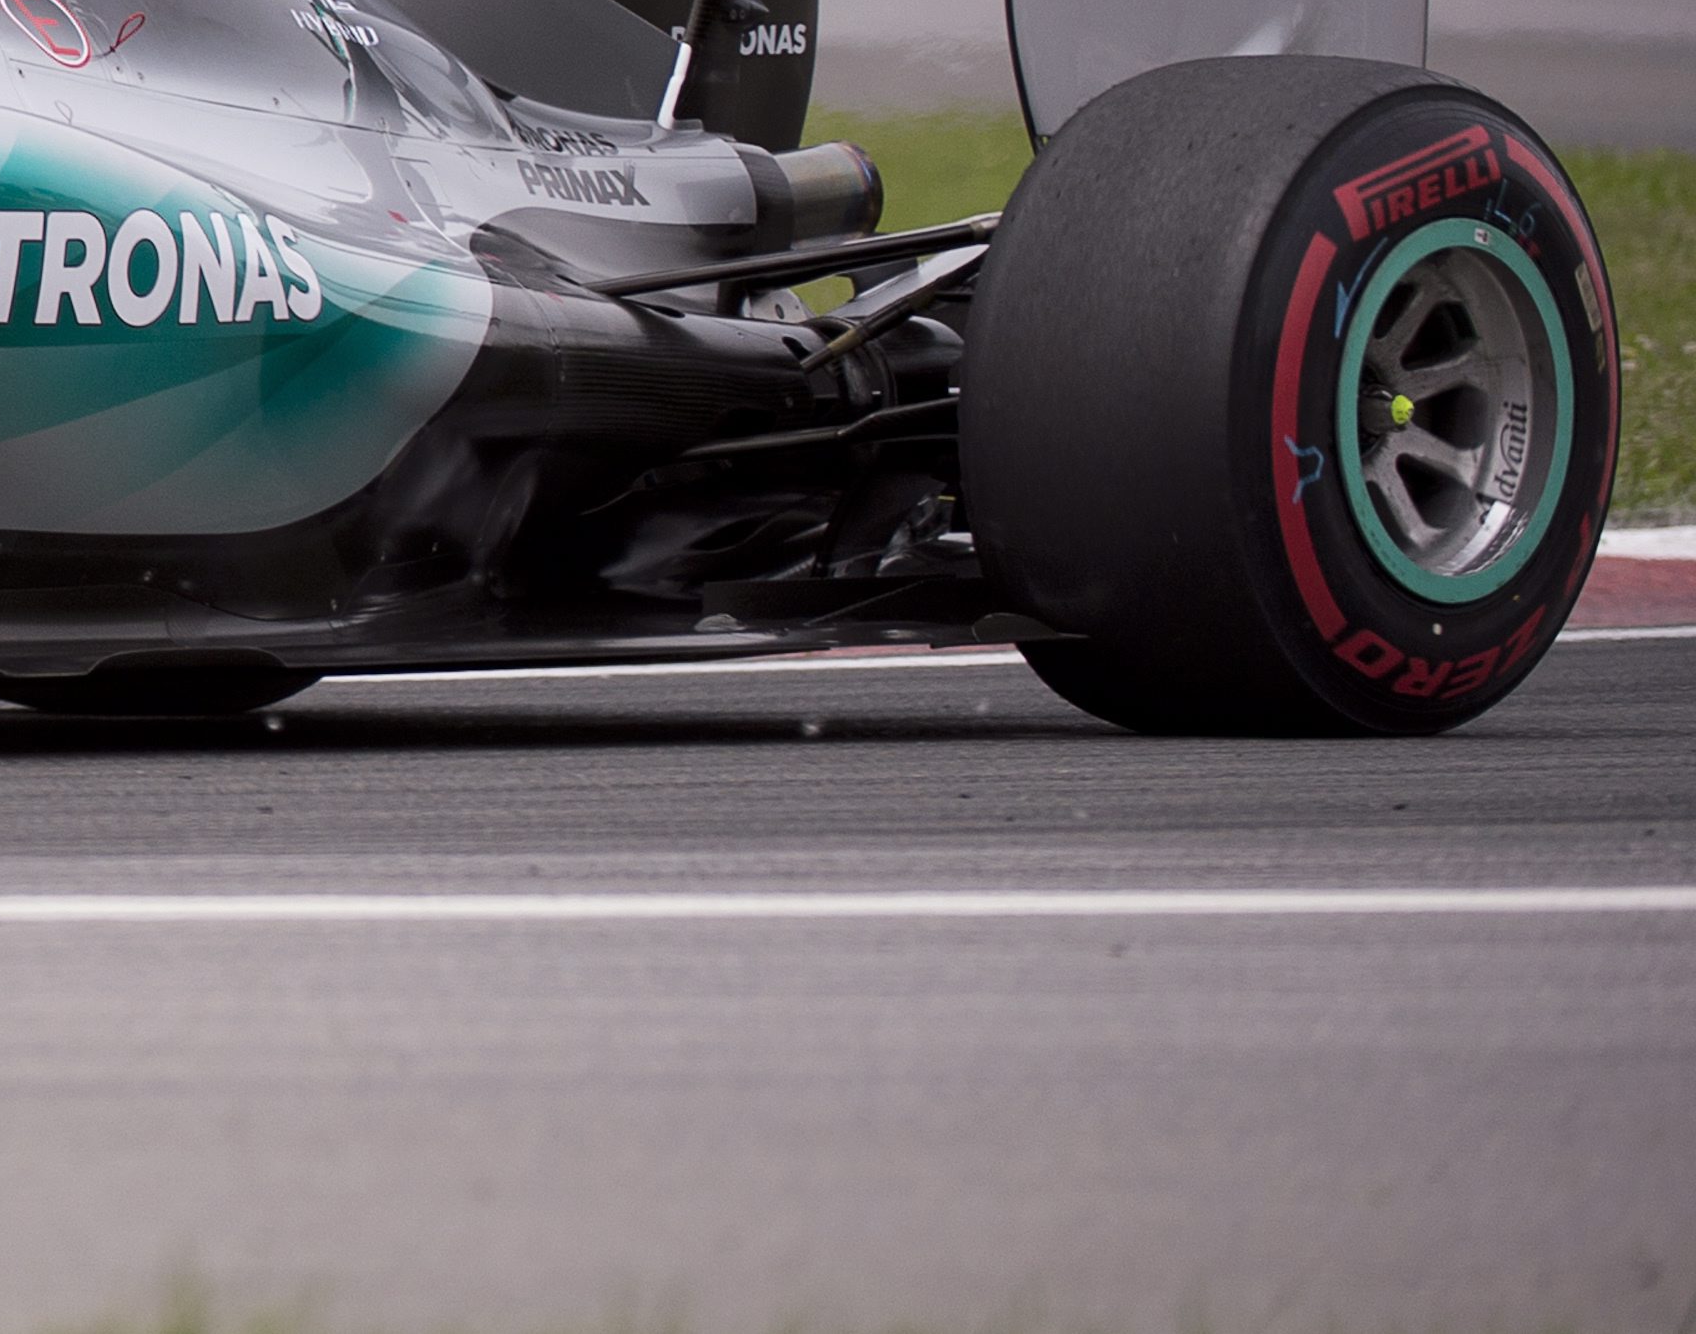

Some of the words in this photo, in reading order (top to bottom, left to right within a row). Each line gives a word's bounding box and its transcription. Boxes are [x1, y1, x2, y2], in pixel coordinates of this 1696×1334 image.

[517, 159, 651, 206] PRIMAX
[1332, 124, 1503, 242] PIRELLI
[1332, 604, 1547, 700] ZERO
